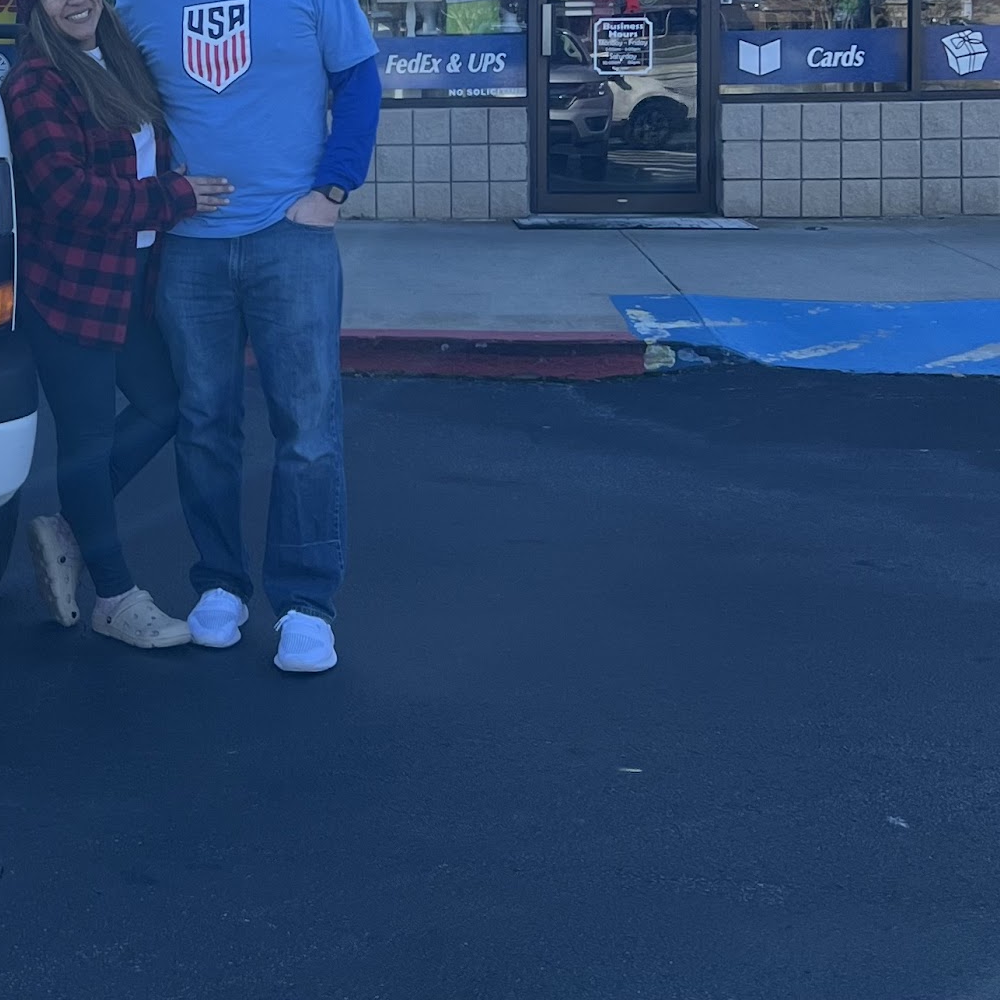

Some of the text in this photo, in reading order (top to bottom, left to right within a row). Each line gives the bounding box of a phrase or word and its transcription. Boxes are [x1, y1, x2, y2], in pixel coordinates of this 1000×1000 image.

[187, 4, 245, 40] USA
[602, 22, 645, 30] Business
[608, 30, 638, 38] Hours
[385, 52, 507, 74] FedEx & UPS
[806, 44, 866, 68] Cards
[448, 88, 464, 97] NO
